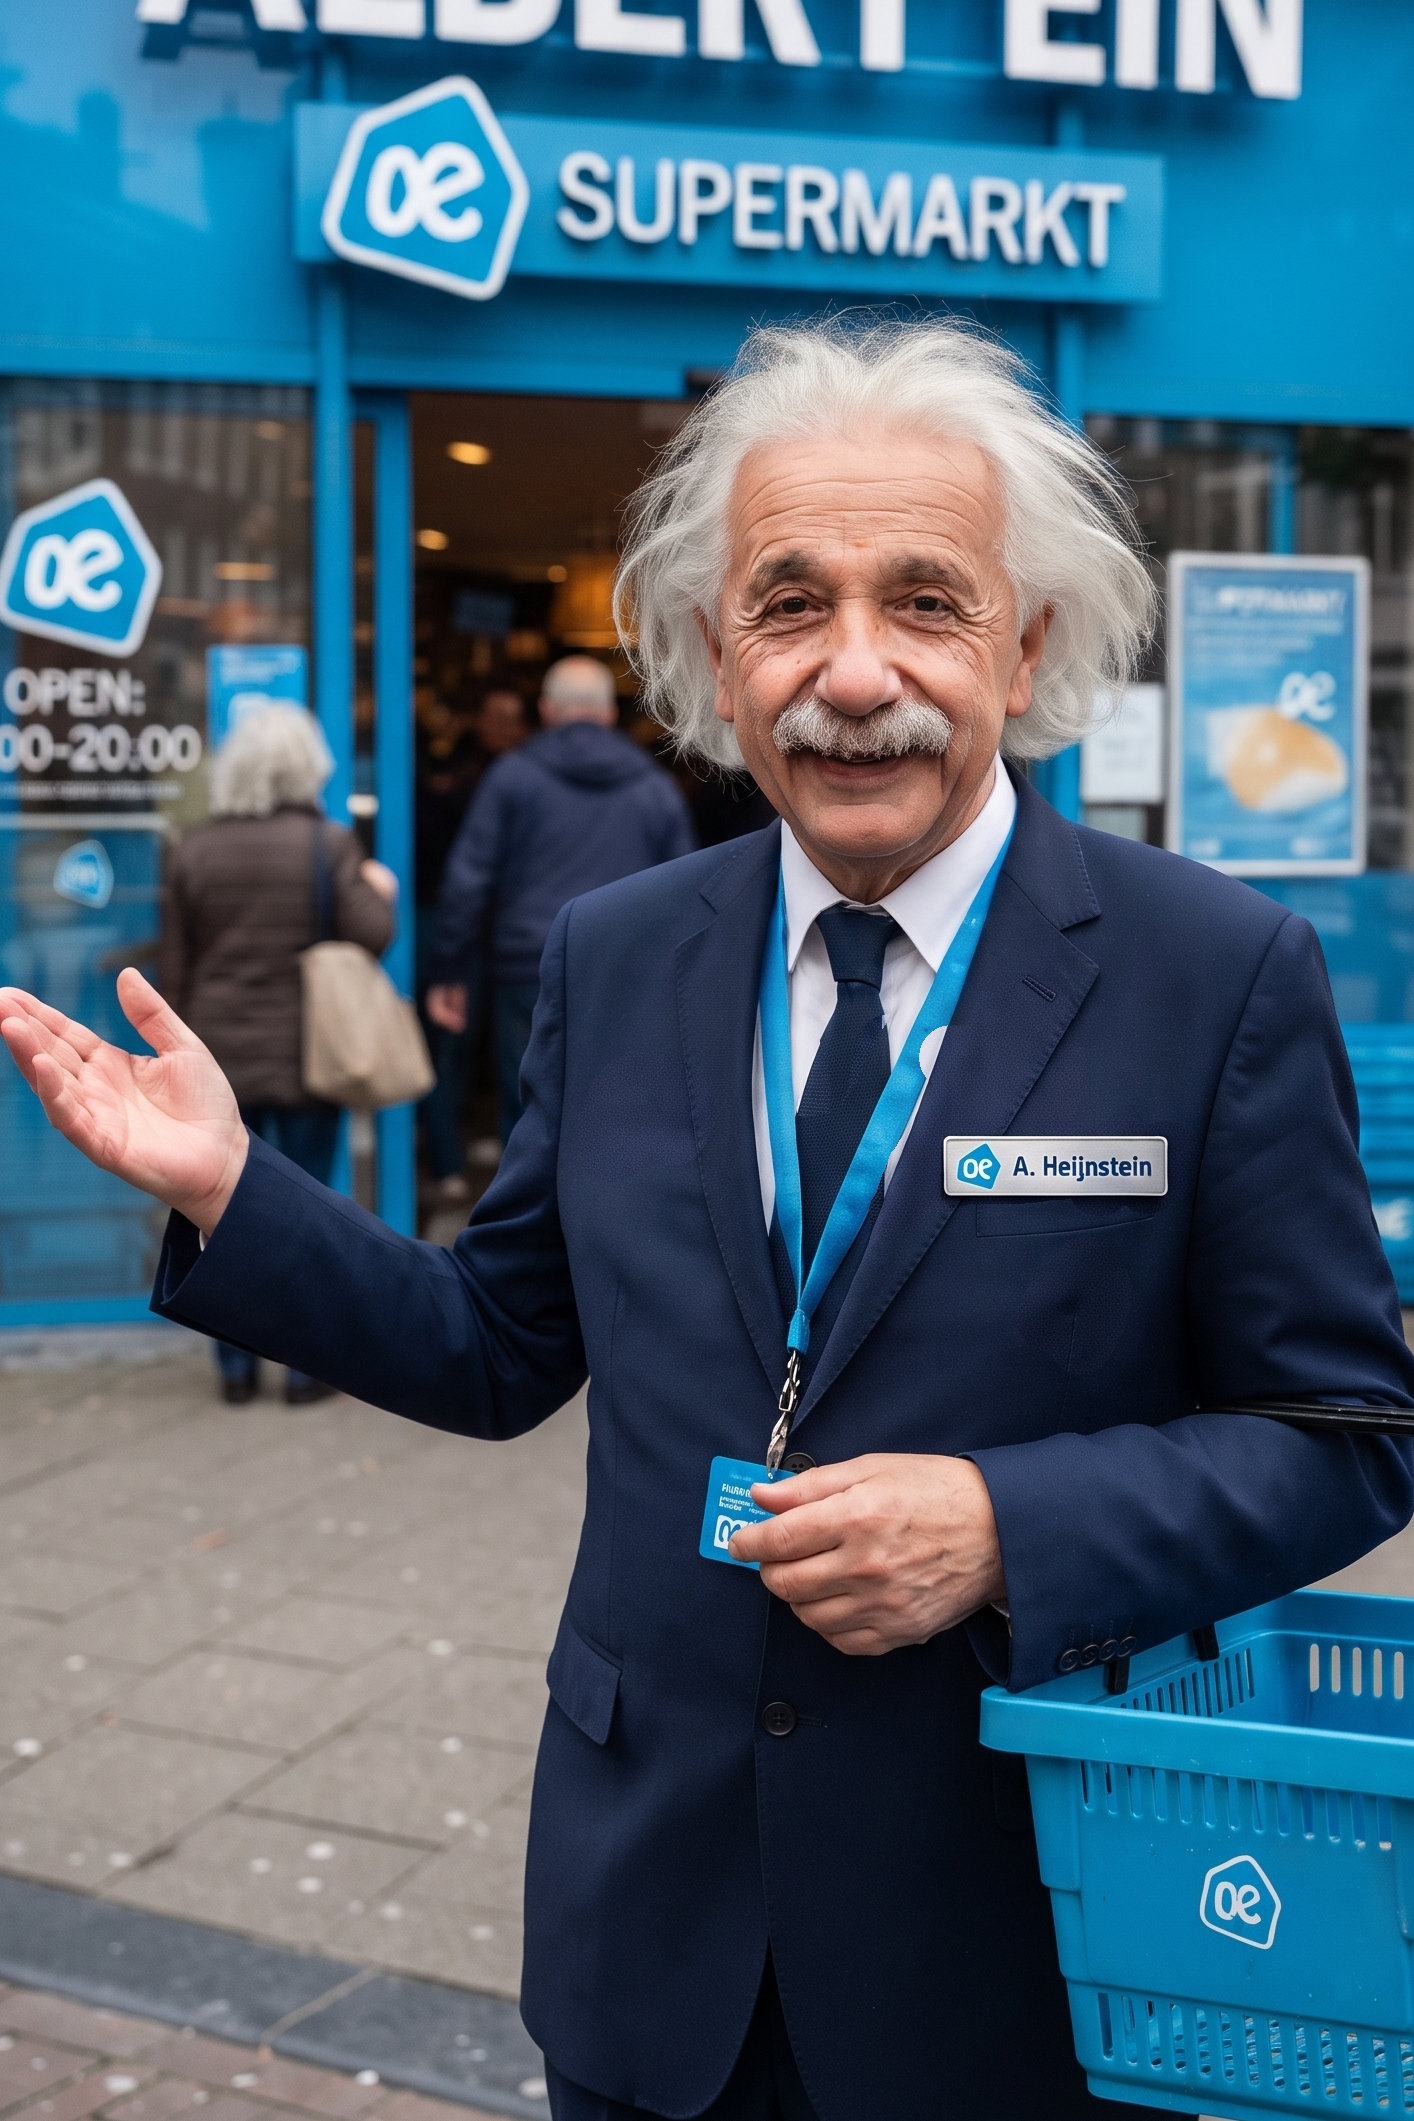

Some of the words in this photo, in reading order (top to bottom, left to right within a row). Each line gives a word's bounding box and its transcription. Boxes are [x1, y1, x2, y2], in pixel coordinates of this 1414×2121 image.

[557, 151, 1126, 268] SUPERMARKT
[3, 667, 146, 717] OPEN:
[1013, 1156, 1035, 1177] A.
[1043, 1156, 1152, 1182] Heijnstein
